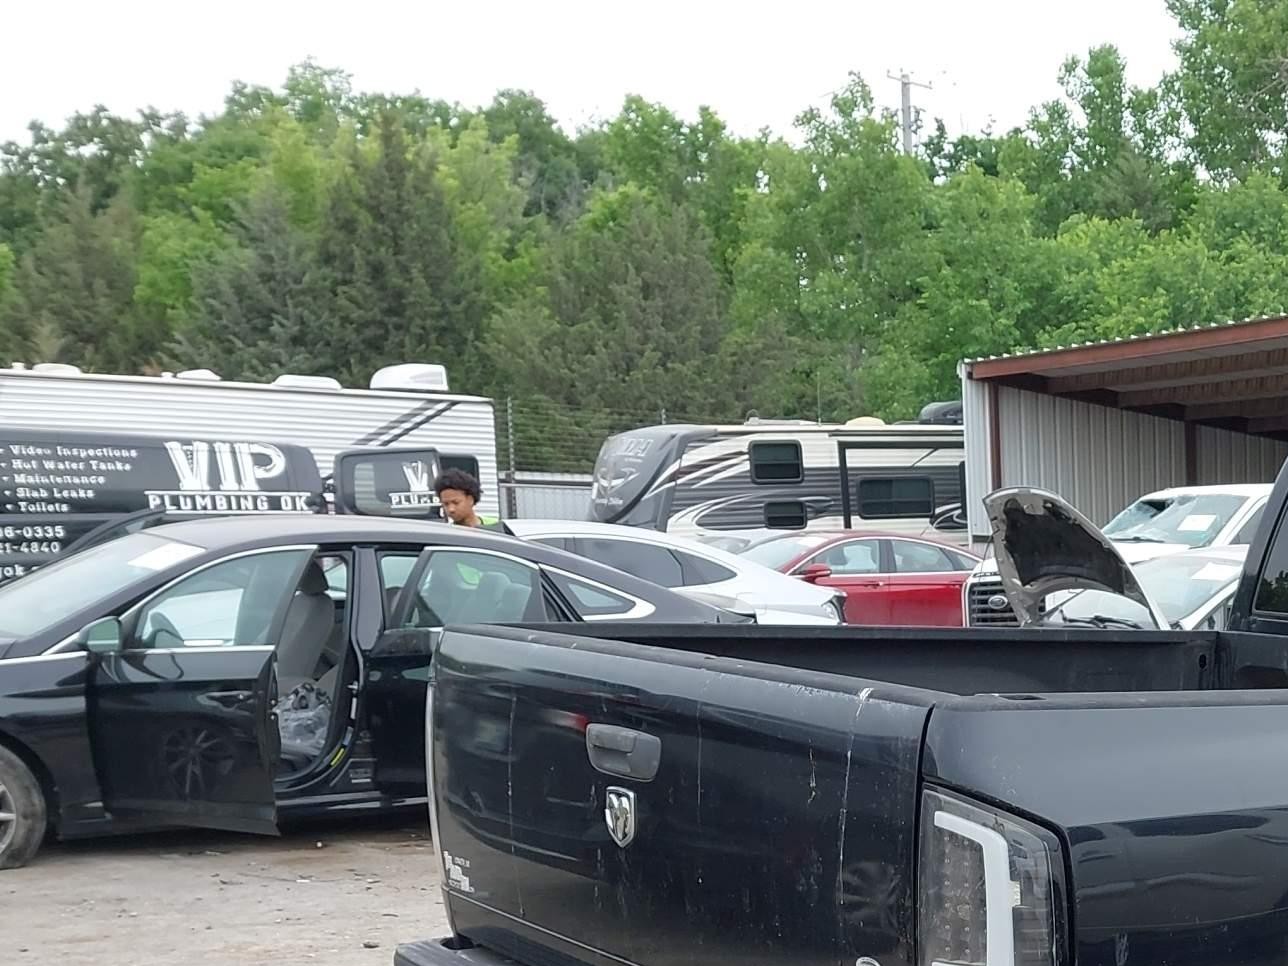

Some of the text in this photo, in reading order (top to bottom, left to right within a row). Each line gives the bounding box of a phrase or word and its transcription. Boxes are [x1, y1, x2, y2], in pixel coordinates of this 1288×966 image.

[9, 444, 138, 458] Video Inspections
[42, 460, 86, 470] Water
[89, 460, 132, 471] Tanks
[163, 440, 286, 491] VIP
[13, 473, 106, 484] Maintenance
[16, 487, 96, 499] Slab Leaks
[18, 502, 70, 513] Toilets
[149, 494, 311, 511] PLUMBING OK
